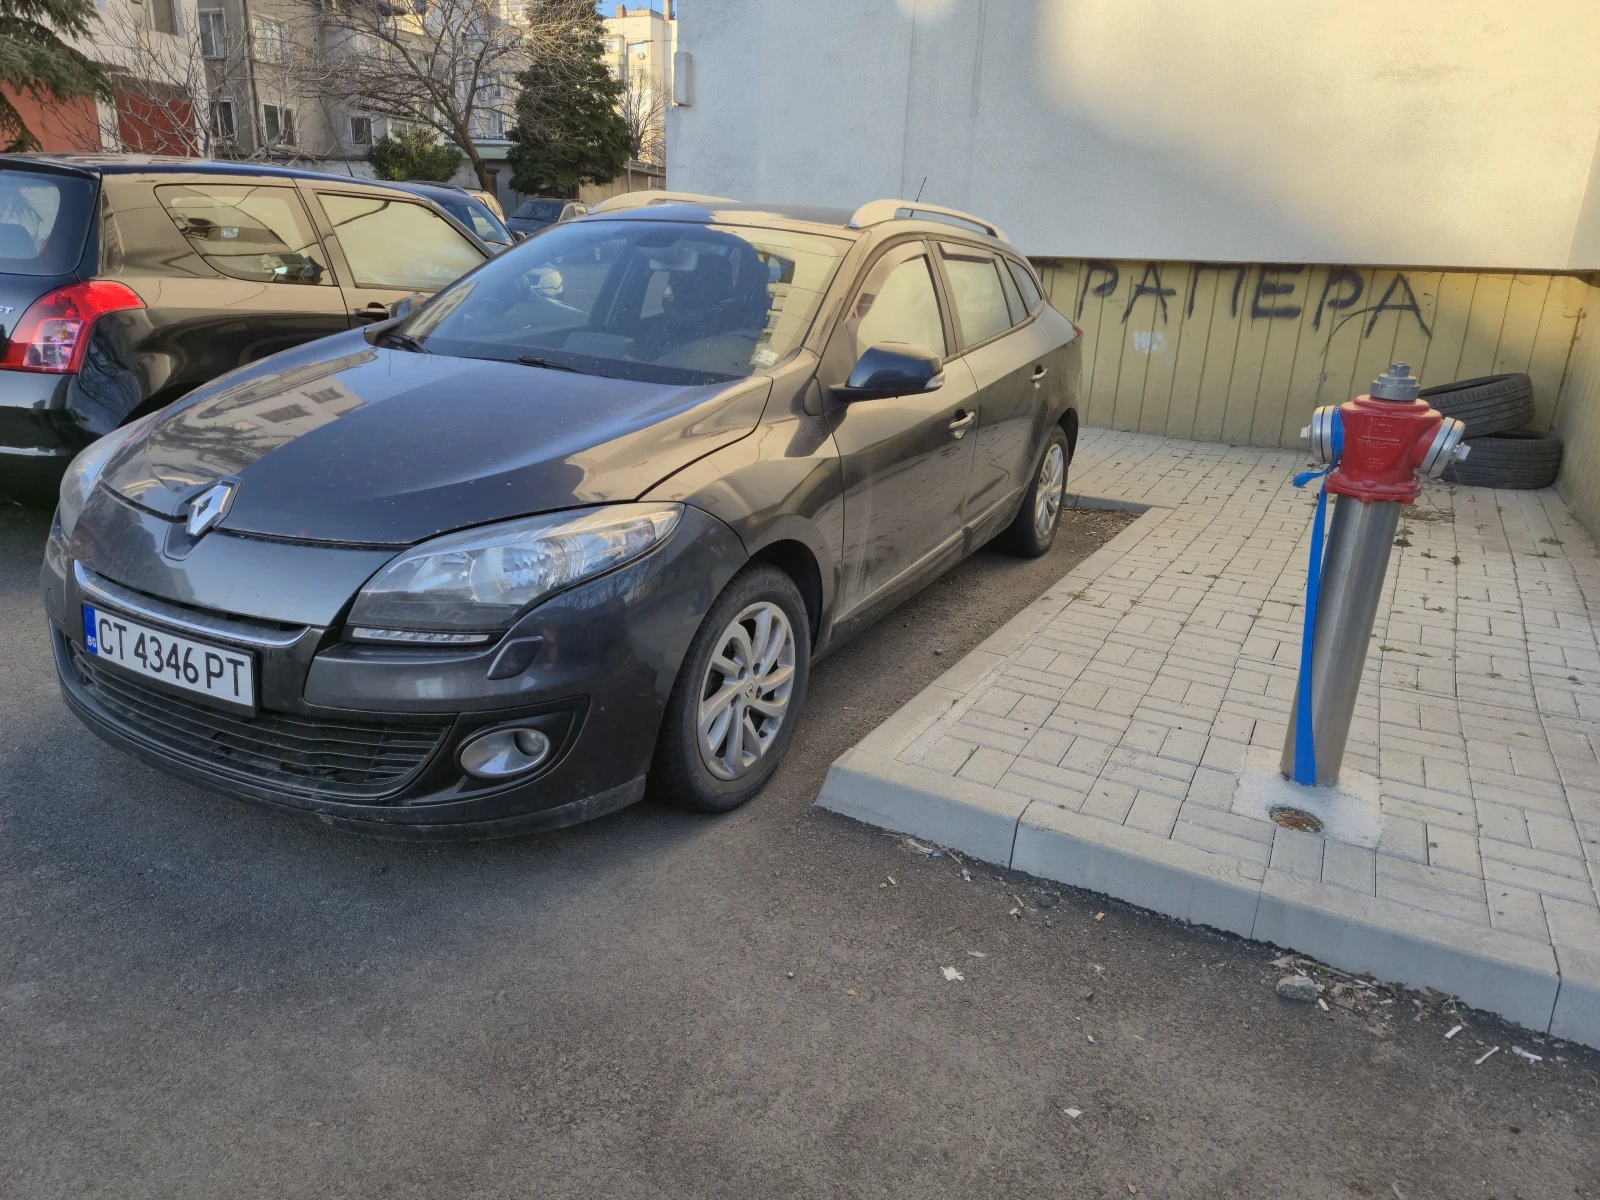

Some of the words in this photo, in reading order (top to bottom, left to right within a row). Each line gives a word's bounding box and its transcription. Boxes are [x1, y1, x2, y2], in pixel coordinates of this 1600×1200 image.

[87, 634, 97, 648] BG
[99, 618, 127, 660] CT
[134, 632, 199, 684] 4346
[205, 652, 245, 697] PT
